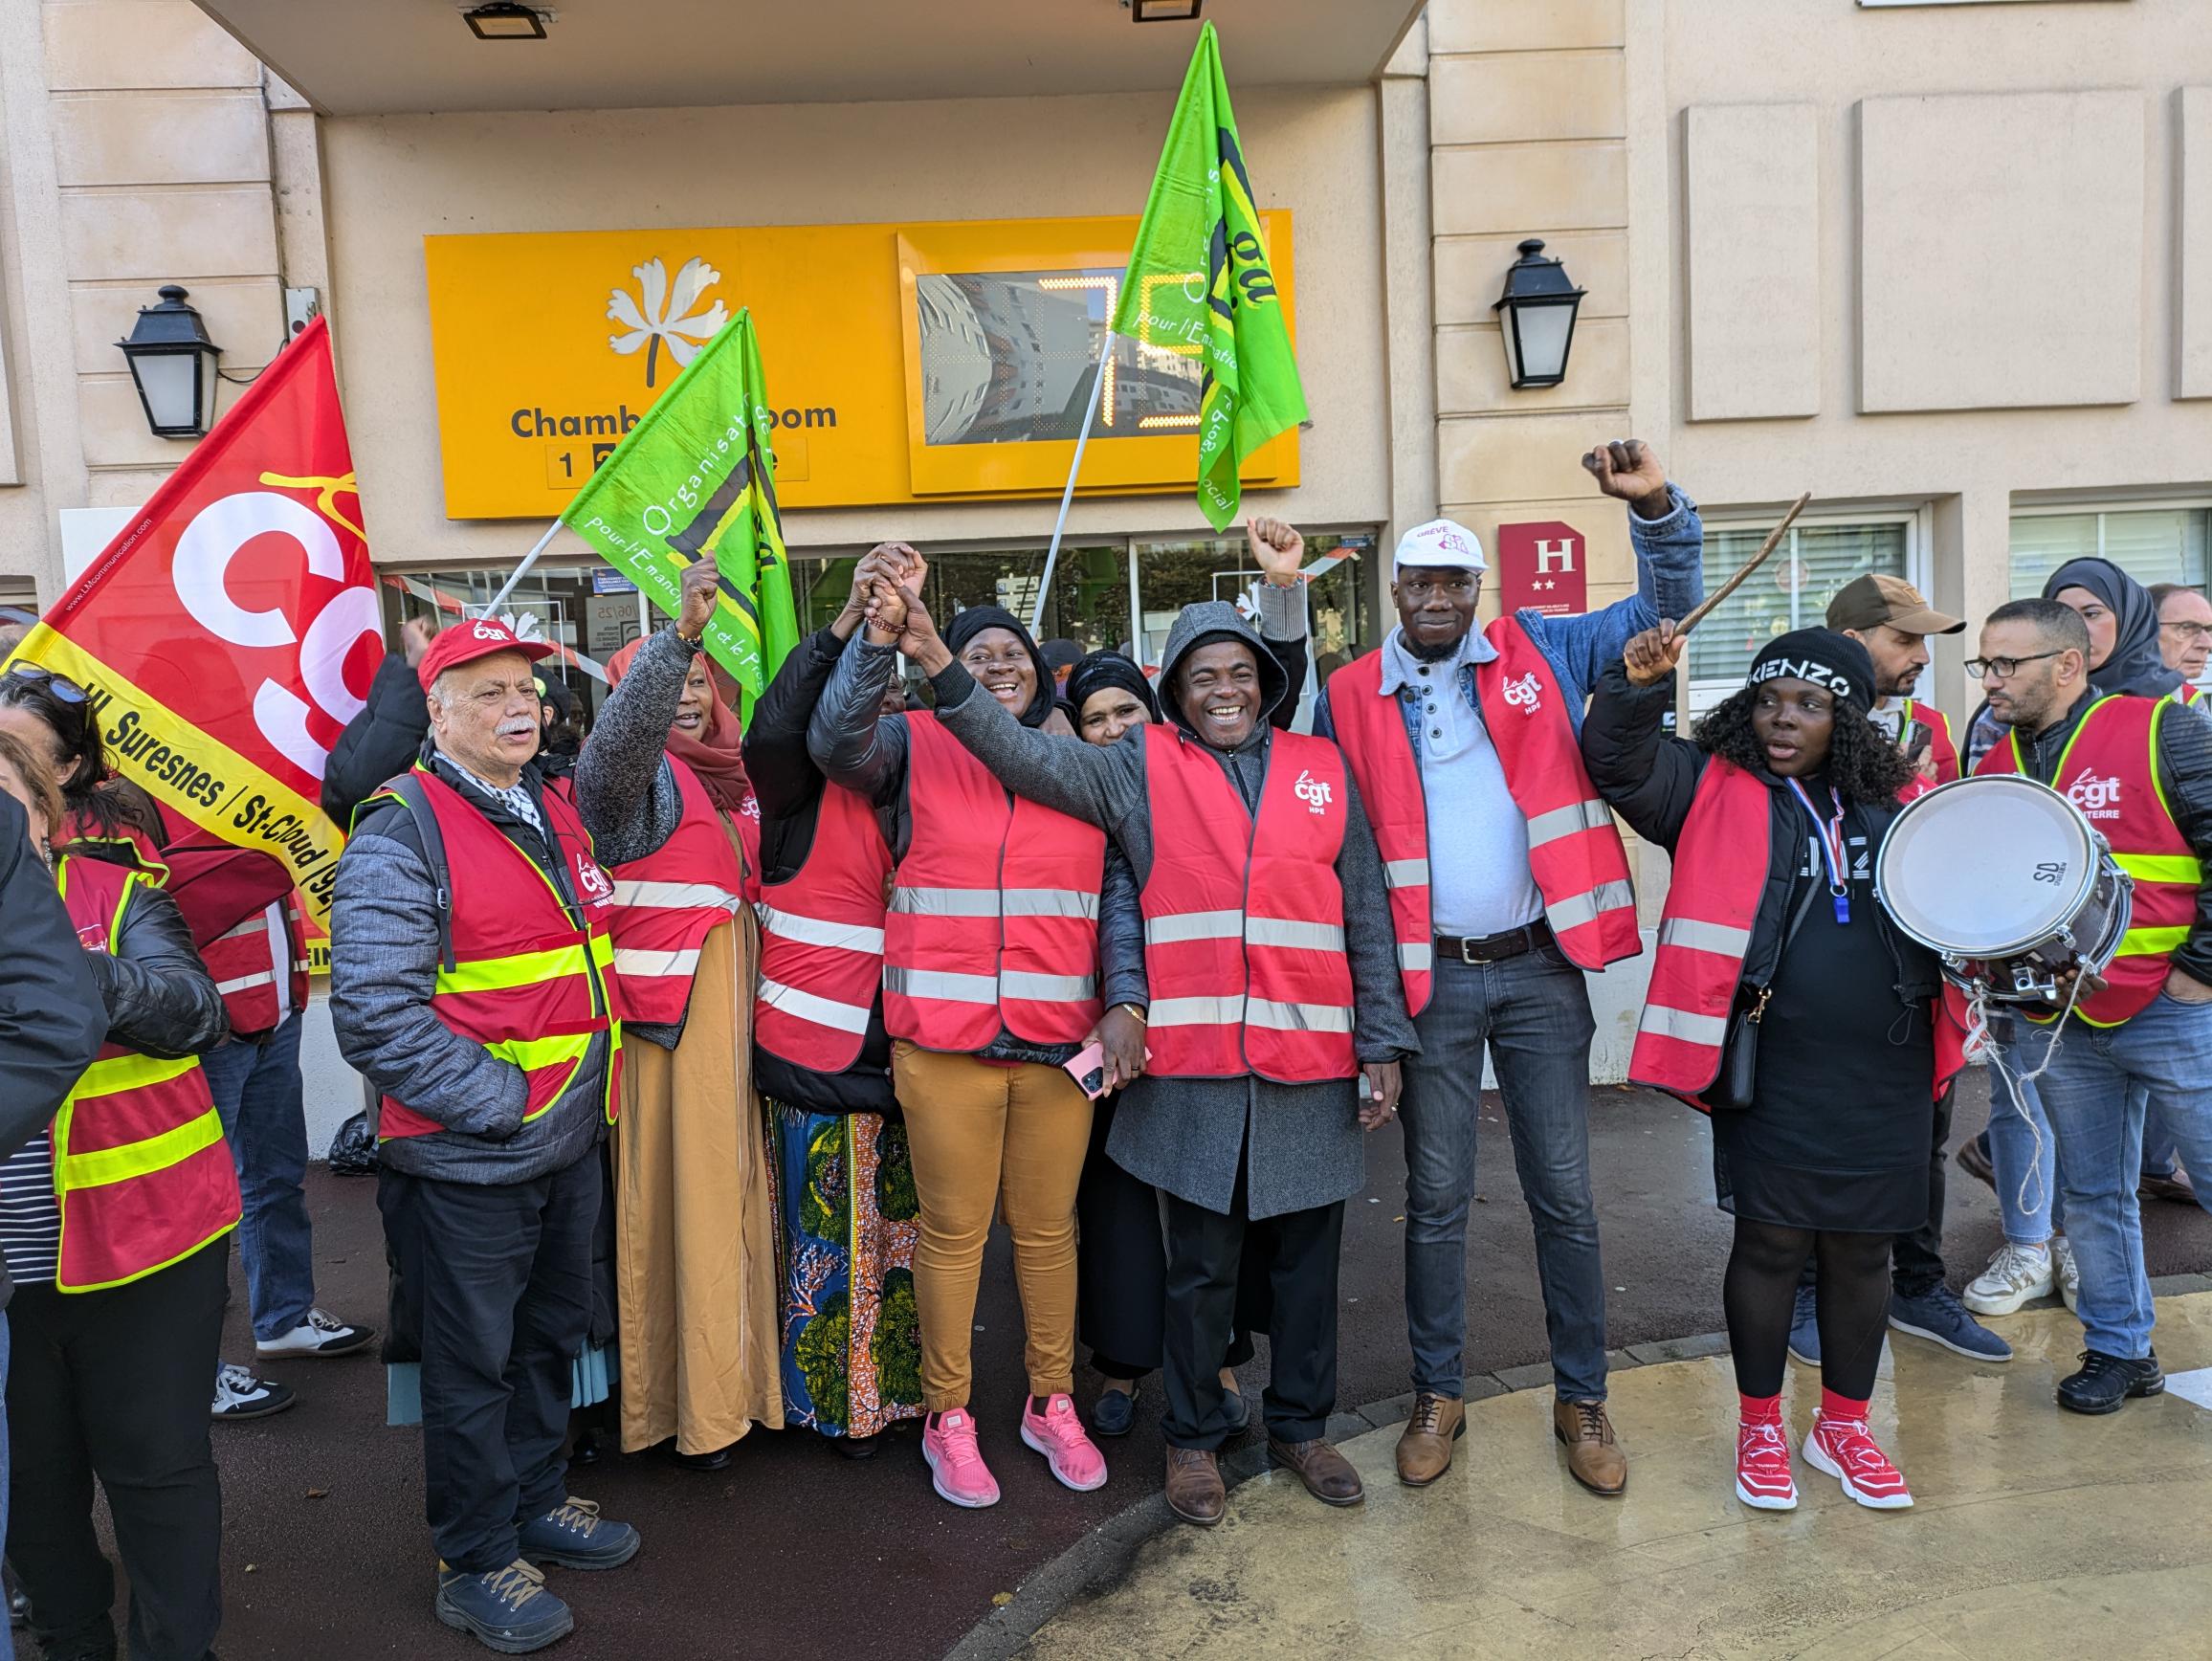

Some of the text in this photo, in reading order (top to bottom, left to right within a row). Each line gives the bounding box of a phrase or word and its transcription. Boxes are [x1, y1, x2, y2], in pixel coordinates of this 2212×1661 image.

[511, 405, 640, 438] Chamb
[1202, 479, 1234, 511] ocial
[1533, 538, 1578, 574] H
[584, 517, 627, 549] pour
[729, 638, 746, 656] le
[171, 491, 386, 782] cg
[1503, 672, 1542, 706] cgt
[1745, 657, 1851, 698] KENZO
[104, 710, 226, 808] Suresnes
[232, 794, 330, 869] St-Cloud
[1294, 782, 1333, 807] cgt
[2067, 776, 2121, 809] cgt
[2086, 809, 2120, 819] TERRE
